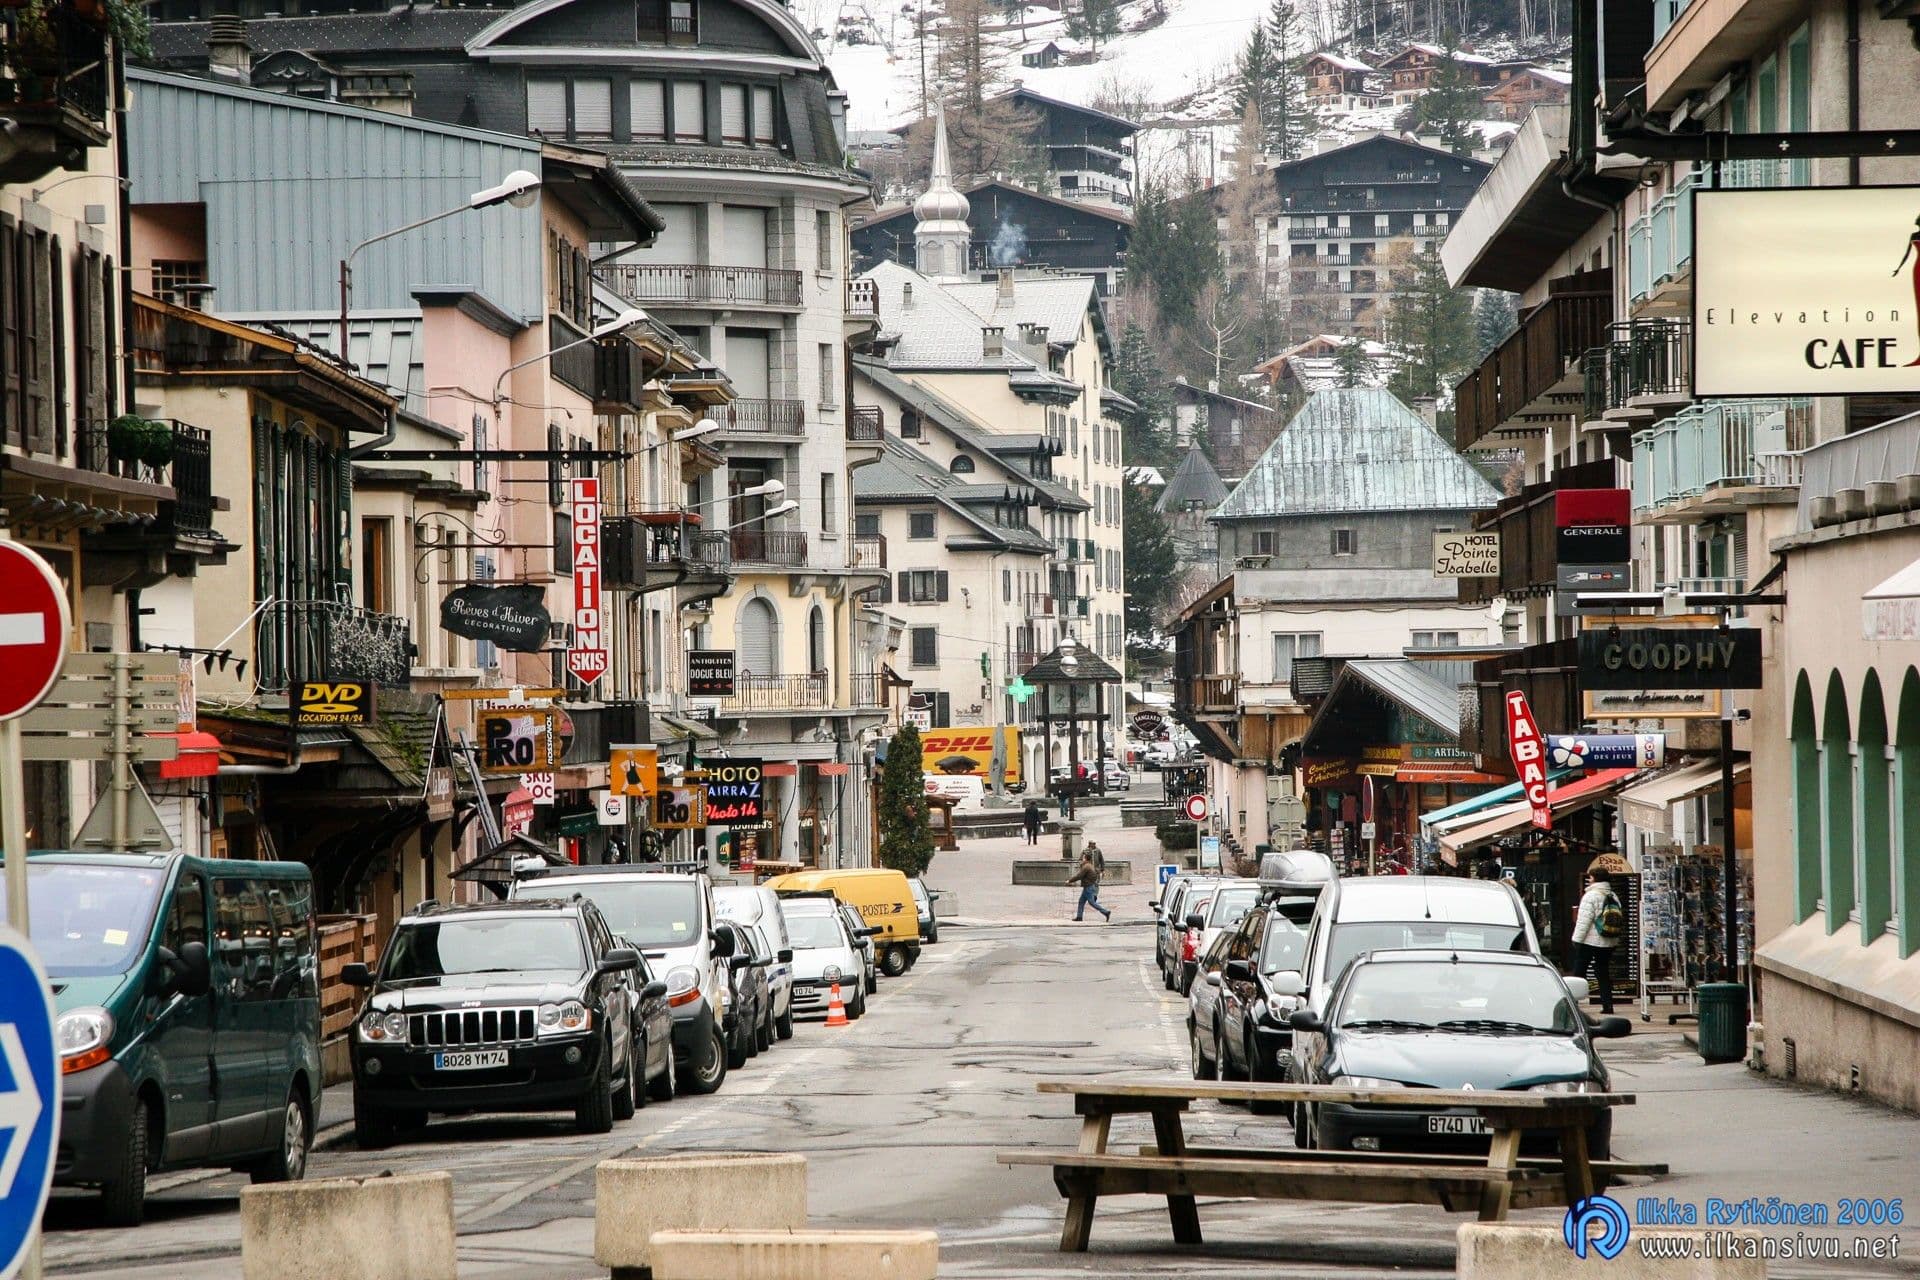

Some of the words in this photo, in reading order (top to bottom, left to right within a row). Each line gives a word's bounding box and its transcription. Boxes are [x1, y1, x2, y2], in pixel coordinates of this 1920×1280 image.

[1706, 307, 1899, 325] Elevation
[1804, 337, 1897, 369] CAFE
[1562, 528, 1623, 536] GENERALE
[1464, 536, 1497, 546] HOTEL
[1443, 542, 1497, 560] Pointe
[574, 483, 599, 650] LOCATION
[1437, 558, 1497, 574] Isabelle
[450, 598, 489, 618] Rêves
[571, 652, 606, 671] SKIS
[1603, 641, 1736, 671] GOOPHY
[690, 668, 714, 679] DOGUE
[716, 668, 732, 679] BLEU
[302, 683, 362, 704] DVD
[298, 714, 338, 722] LOCATION
[339, 714, 363, 722] 24/24
[546, 715, 554, 765] ROSSIGNOL
[923, 736, 993, 752] DHL
[1509, 697, 1546, 804] TABAC
[699, 766, 761, 782] PHOTO
[527, 785, 553, 798] OC
[700, 782, 761, 798] AIRRAZ
[704, 804, 738, 819] Photo
[741, 801, 757, 816] 1h
[862, 903, 889, 916] POSTE
[443, 1054, 472, 1067] 8028
[474, 1052, 489, 1065] YM
[491, 1051, 505, 1065] 74
[1430, 1117, 1463, 1133] 8740
